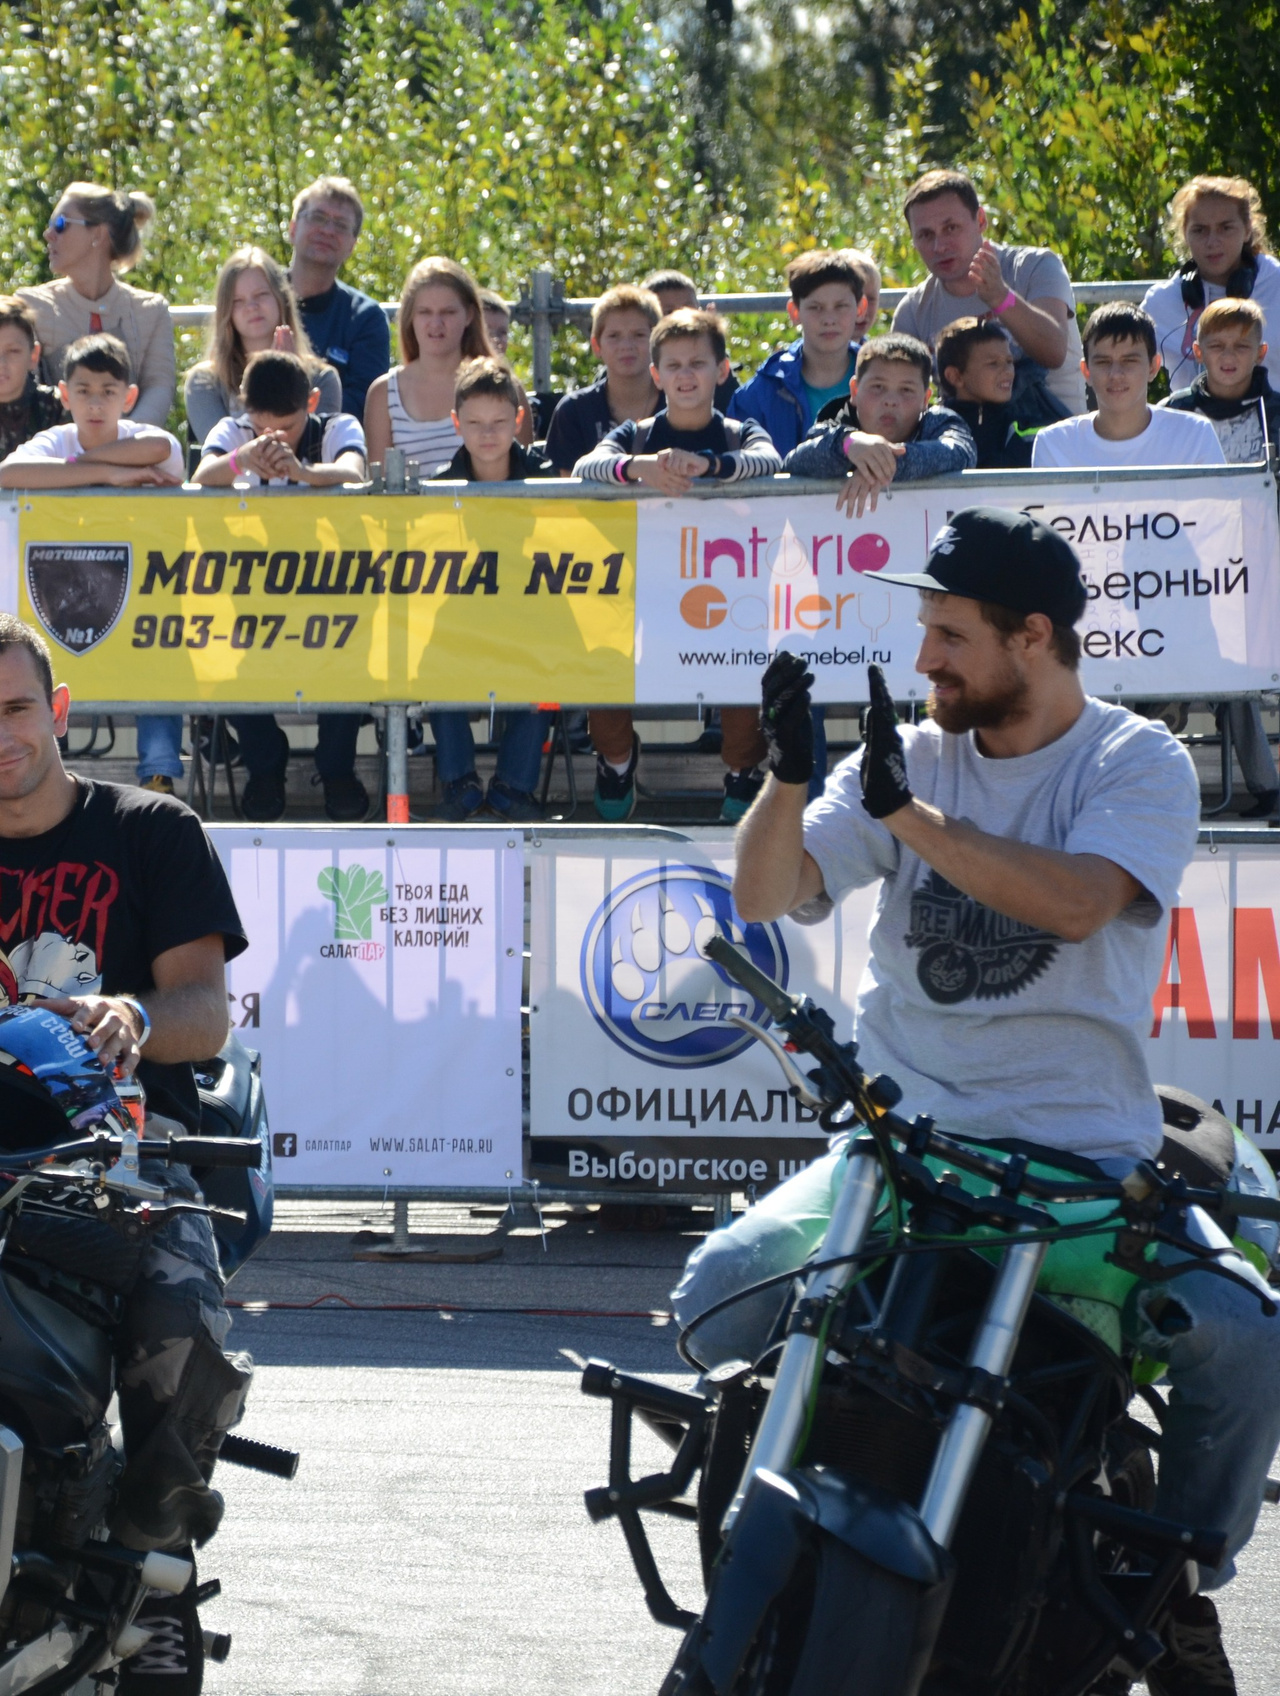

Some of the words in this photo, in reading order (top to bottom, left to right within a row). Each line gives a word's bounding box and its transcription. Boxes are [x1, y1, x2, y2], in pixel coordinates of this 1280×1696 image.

[139, 550, 500, 595] МОТОШКОЛА
[525, 552, 625, 595] №1
[131, 614, 359, 649] 903-07-07
[395, 884, 433, 901] ТВОЯ
[439, 884, 469, 904] ЕДА
[380, 907, 408, 924] БЕЗ
[414, 907, 483, 925] ЛИШНИХ
[394, 927, 470, 947] КАЛОРИЙ!
[638, 1002, 749, 1022] СЛЕД
[568, 1087, 819, 1129] ОФИЦИАЛЬ
[369, 1137, 493, 1154] WWW.SALAT-PAR.RU
[568, 1150, 767, 1187] Выборгское
